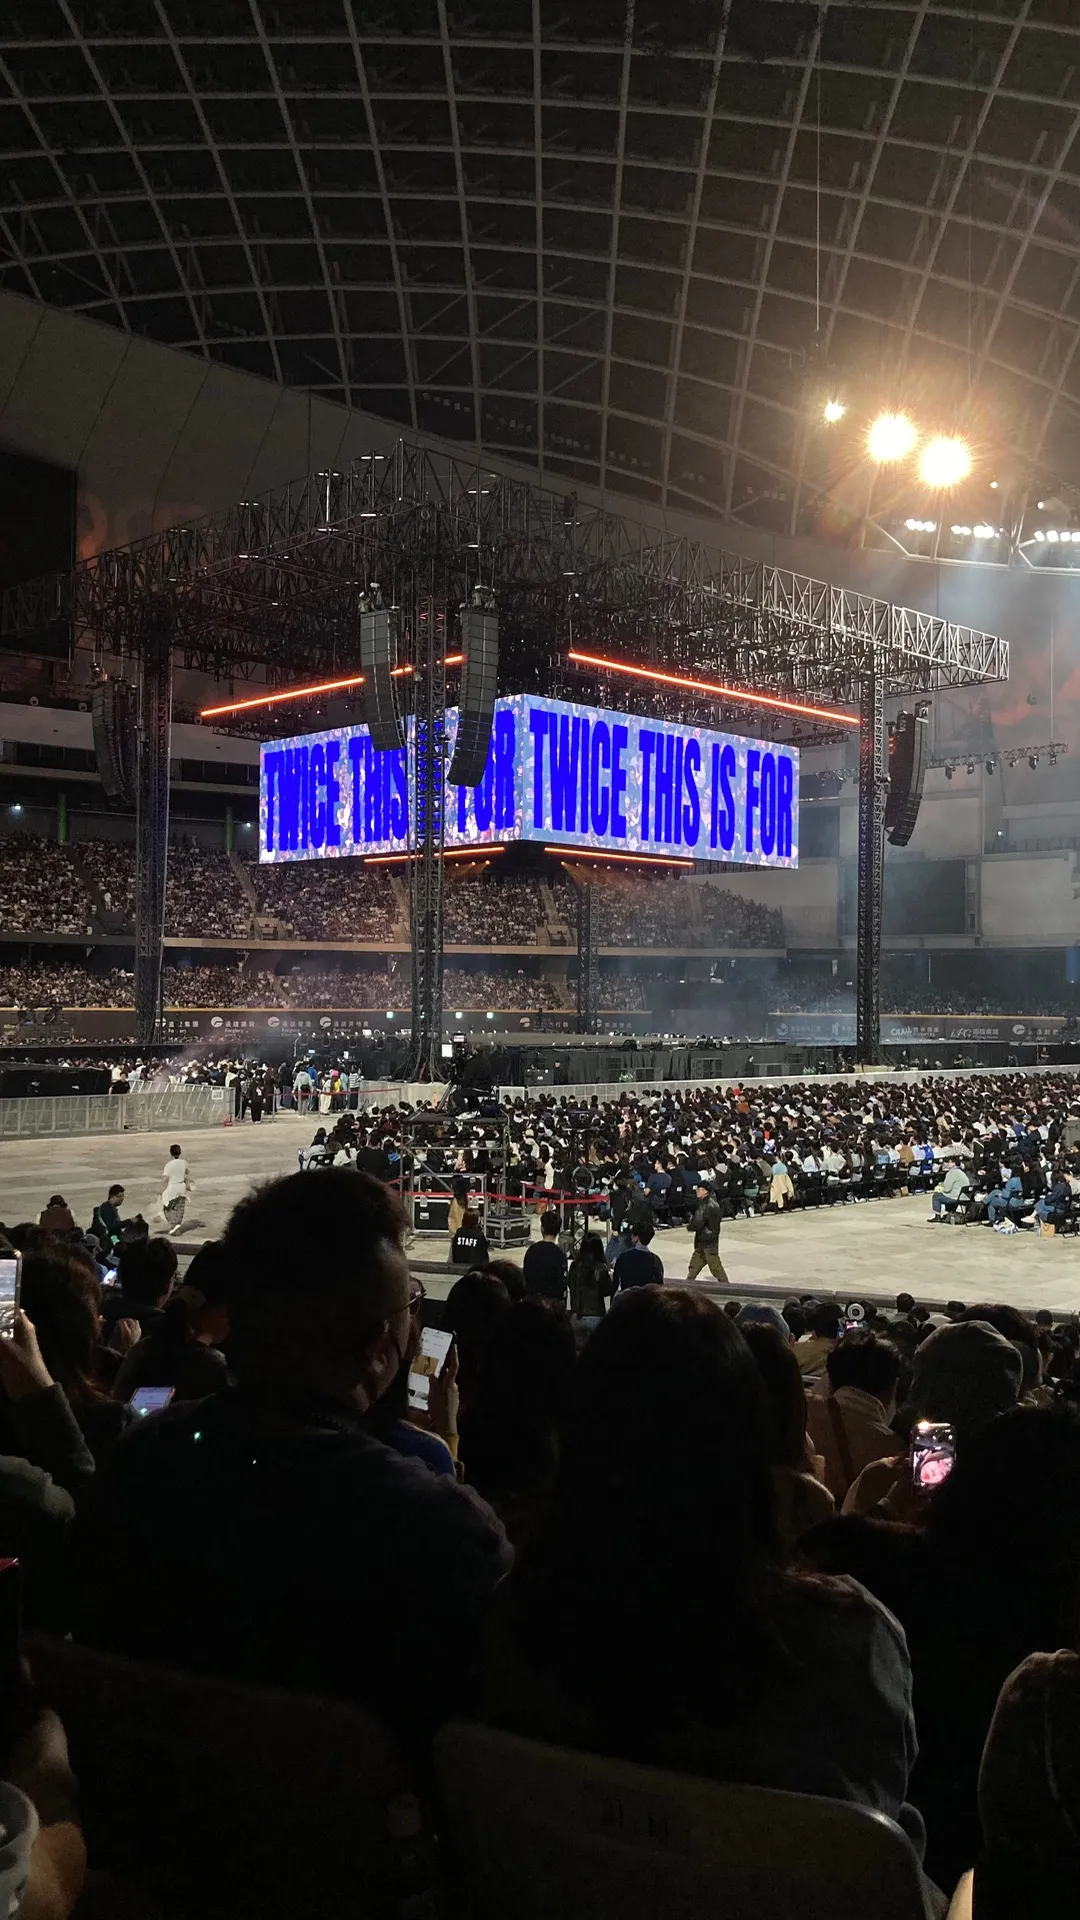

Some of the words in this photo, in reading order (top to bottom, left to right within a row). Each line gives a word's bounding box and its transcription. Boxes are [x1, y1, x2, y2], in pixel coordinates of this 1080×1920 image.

[264, 740, 340, 853] TWICE
[348, 735, 409, 845] THIS
[529, 708, 629, 839] TWICE
[638, 729, 701, 847] THIS
[711, 743, 736, 852] IS
[745, 749, 793, 858] FOR
[457, 1236, 478, 1247] STAFF
